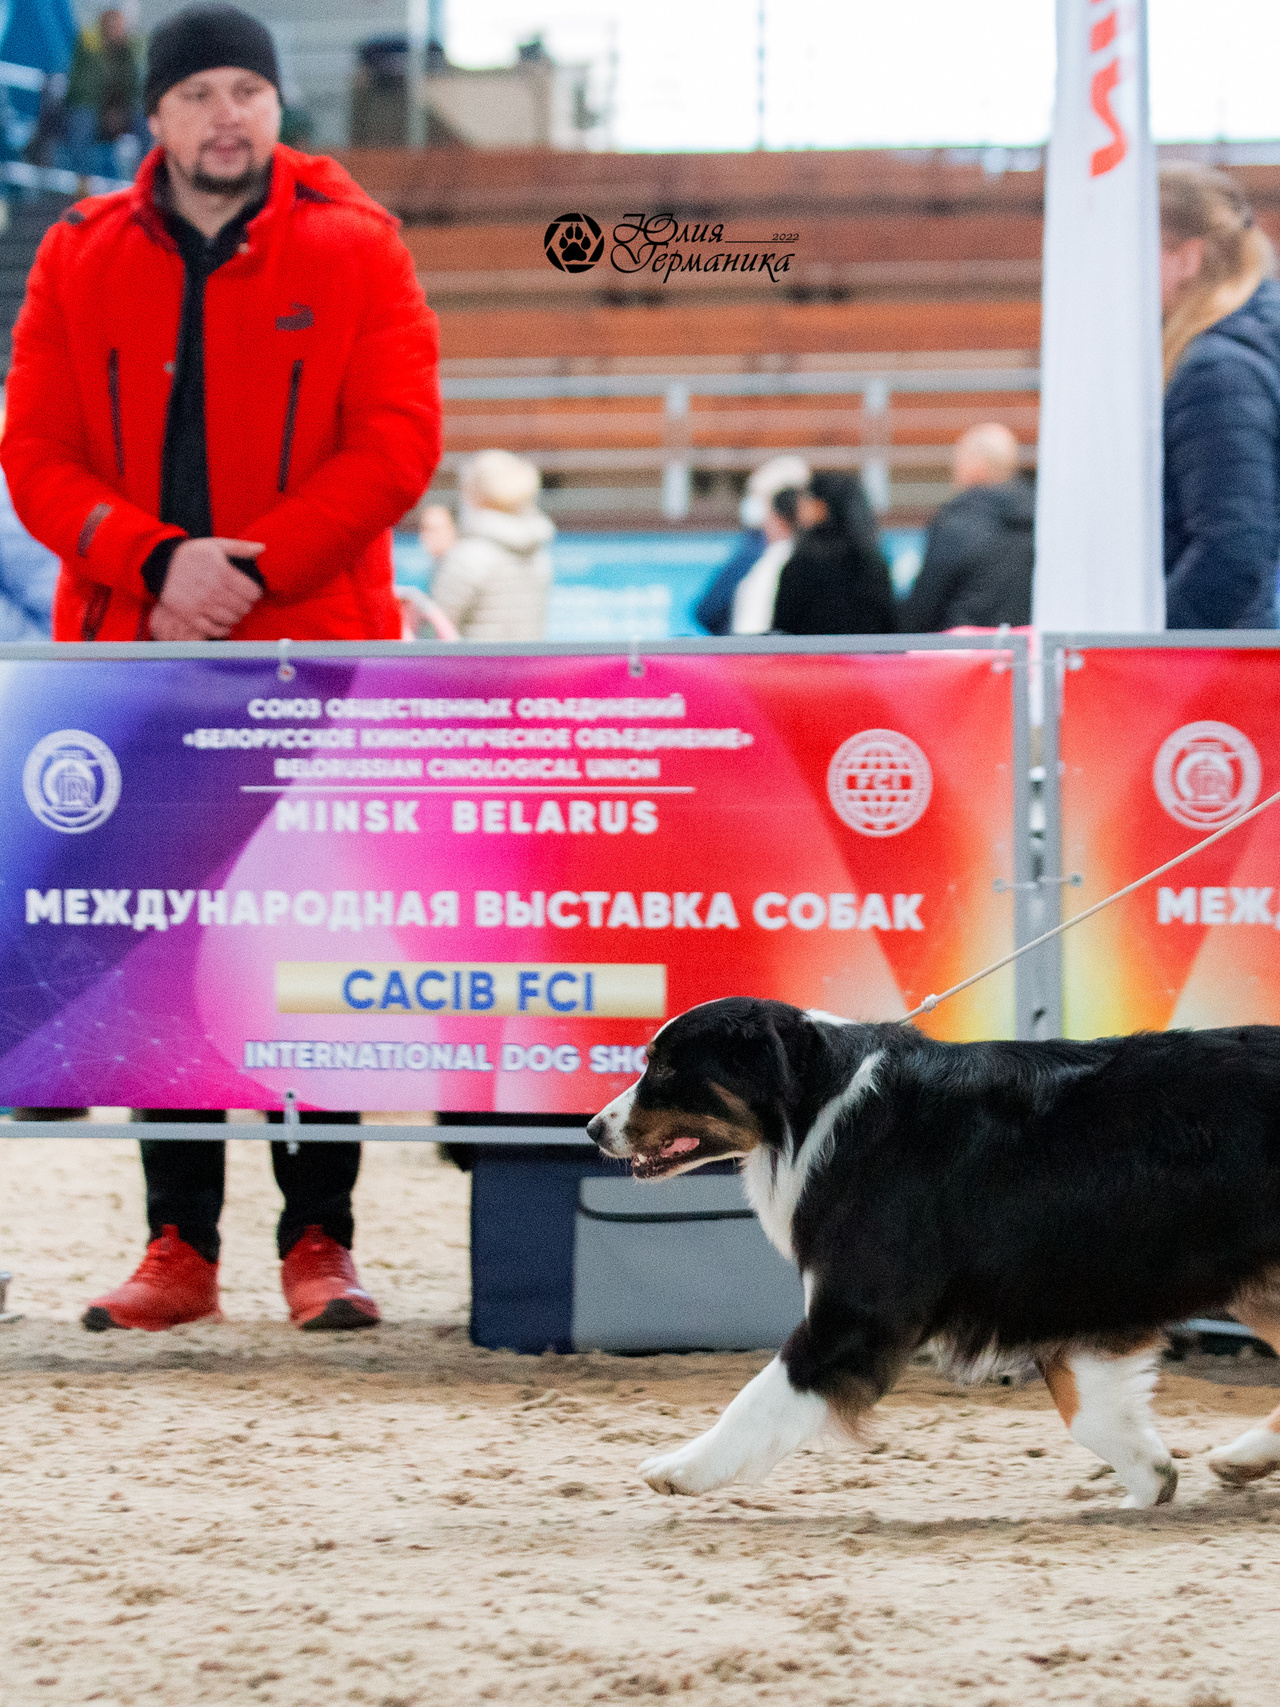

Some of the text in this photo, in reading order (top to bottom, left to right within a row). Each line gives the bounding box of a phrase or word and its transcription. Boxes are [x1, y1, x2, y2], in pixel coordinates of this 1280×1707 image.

[247, 698, 322, 719] СОЮЗ
[585, 758, 660, 778] UNION
[276, 801, 658, 834] MINSK BELARUS
[25, 889, 925, 931] МЕЖДУНАРОДНАЯ ВЫСТАВКА СОБАК
[342, 970, 594, 1012] CACIB FCI
[244, 1041, 648, 1073] INTERNATIONAL DOG SHO
